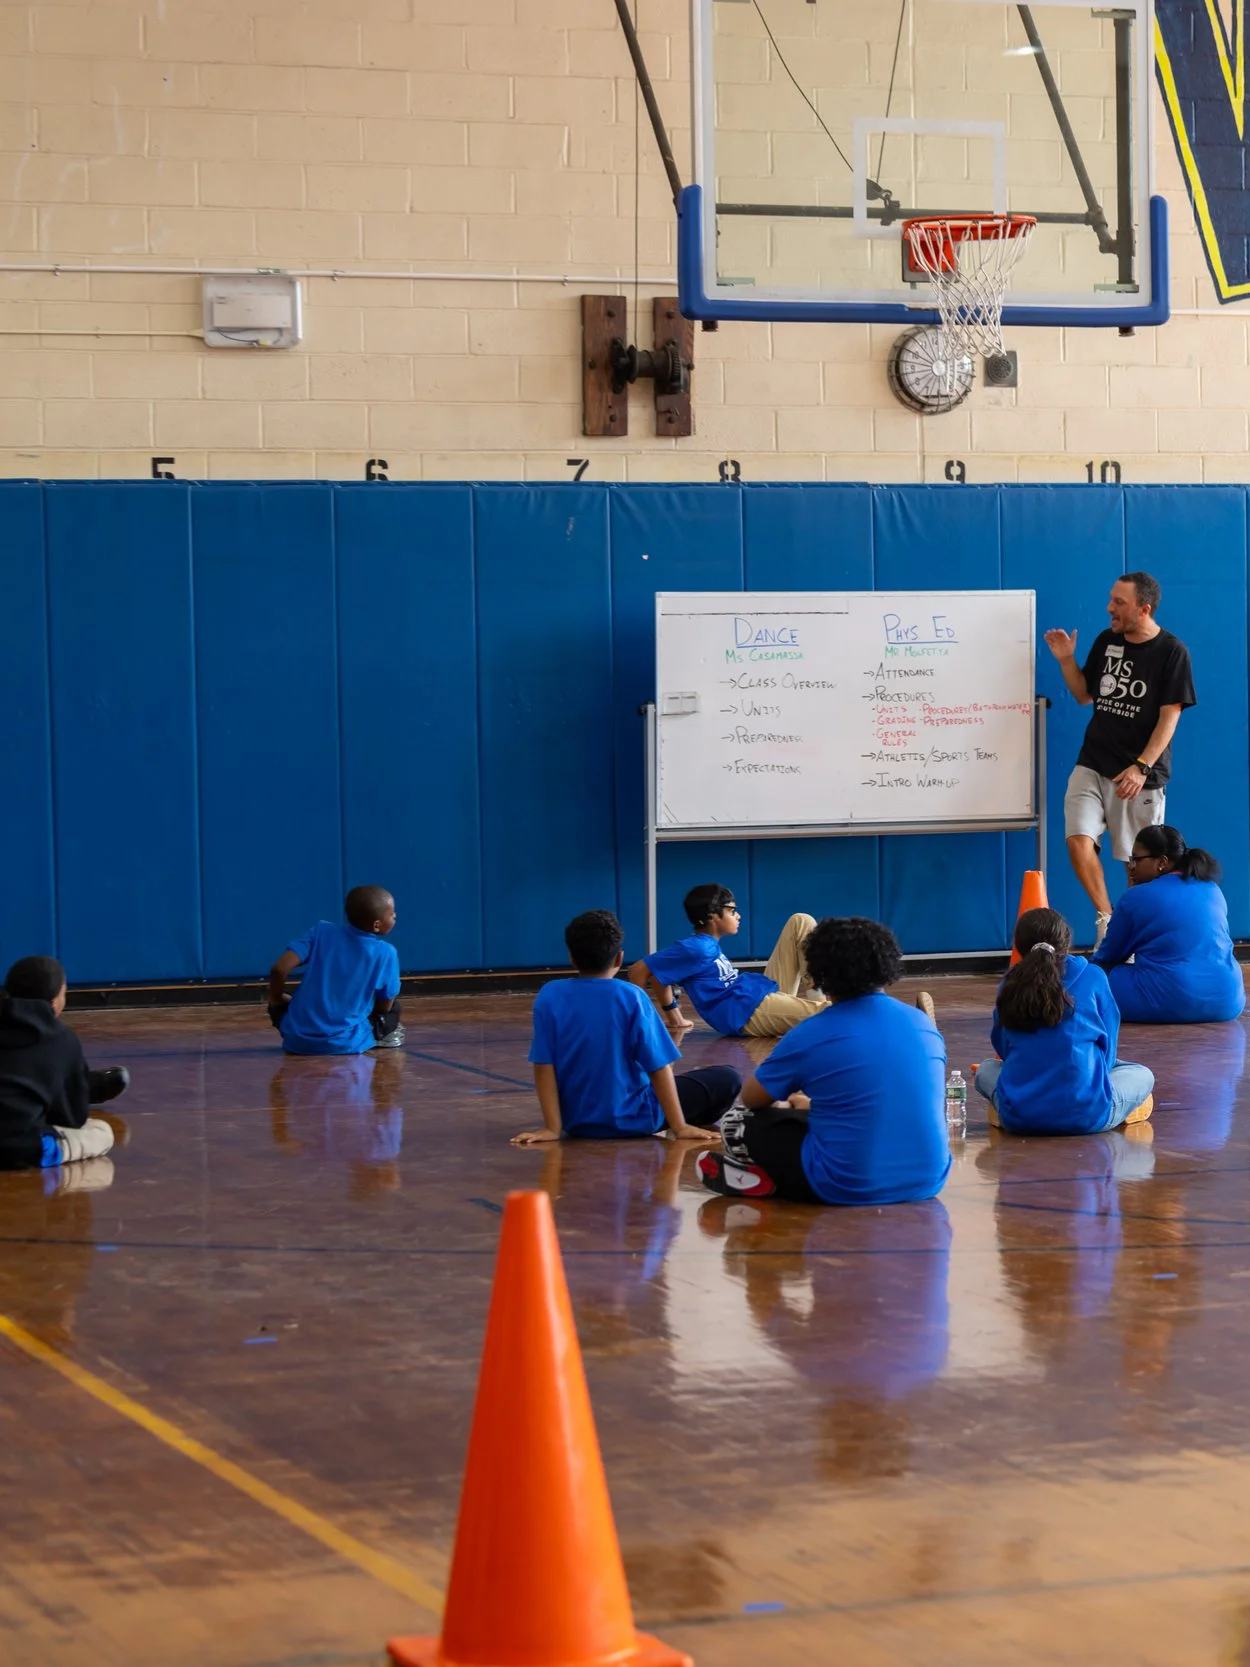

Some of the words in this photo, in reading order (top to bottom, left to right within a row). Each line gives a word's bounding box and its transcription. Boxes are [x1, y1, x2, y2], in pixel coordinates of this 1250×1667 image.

[151, 457, 175, 480] 5
[366, 459, 388, 481] 6
[567, 459, 589, 481] 7
[718, 460, 741, 483] 8
[945, 460, 966, 483] 9
[1086, 461, 1121, 484] 10
[734, 617, 800, 646] DANCE
[932, 615, 955, 638] ED
[875, 661, 935, 681] ATTENDANCE
[1103, 656, 1134, 678] MS
[737, 672, 777, 690] CLASS
[781, 672, 836, 690] OVERVIEW
[1111, 677, 1148, 700] 50
[875, 685, 936, 703] PROCEDURES
[740, 698, 781, 718] UNITS
[1114, 701, 1125, 709] OF
[1126, 703, 1141, 713] THE
[973, 747, 999, 762] TEAMS
[875, 772, 913, 788] INTRO
